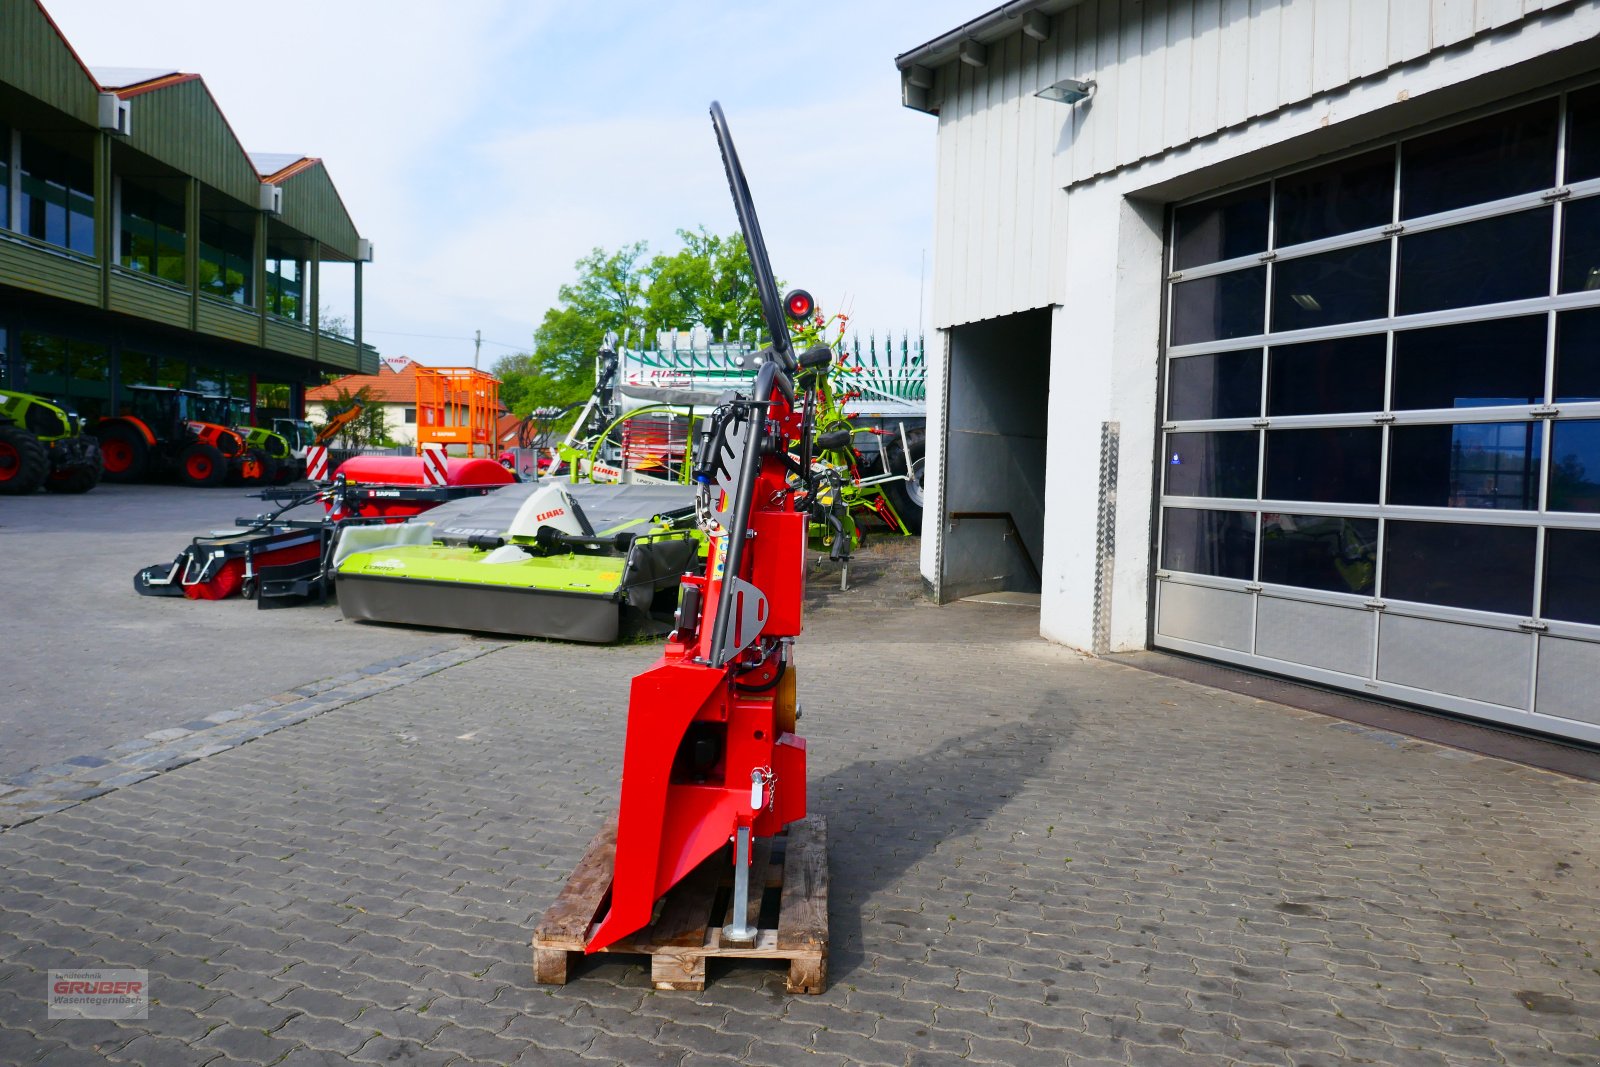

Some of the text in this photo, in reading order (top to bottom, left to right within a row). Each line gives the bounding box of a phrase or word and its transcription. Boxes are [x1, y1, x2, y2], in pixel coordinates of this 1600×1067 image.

[592, 465, 619, 477] CLAAS
[536, 508, 565, 522] CLAAS
[442, 527, 499, 537] CLAAS
